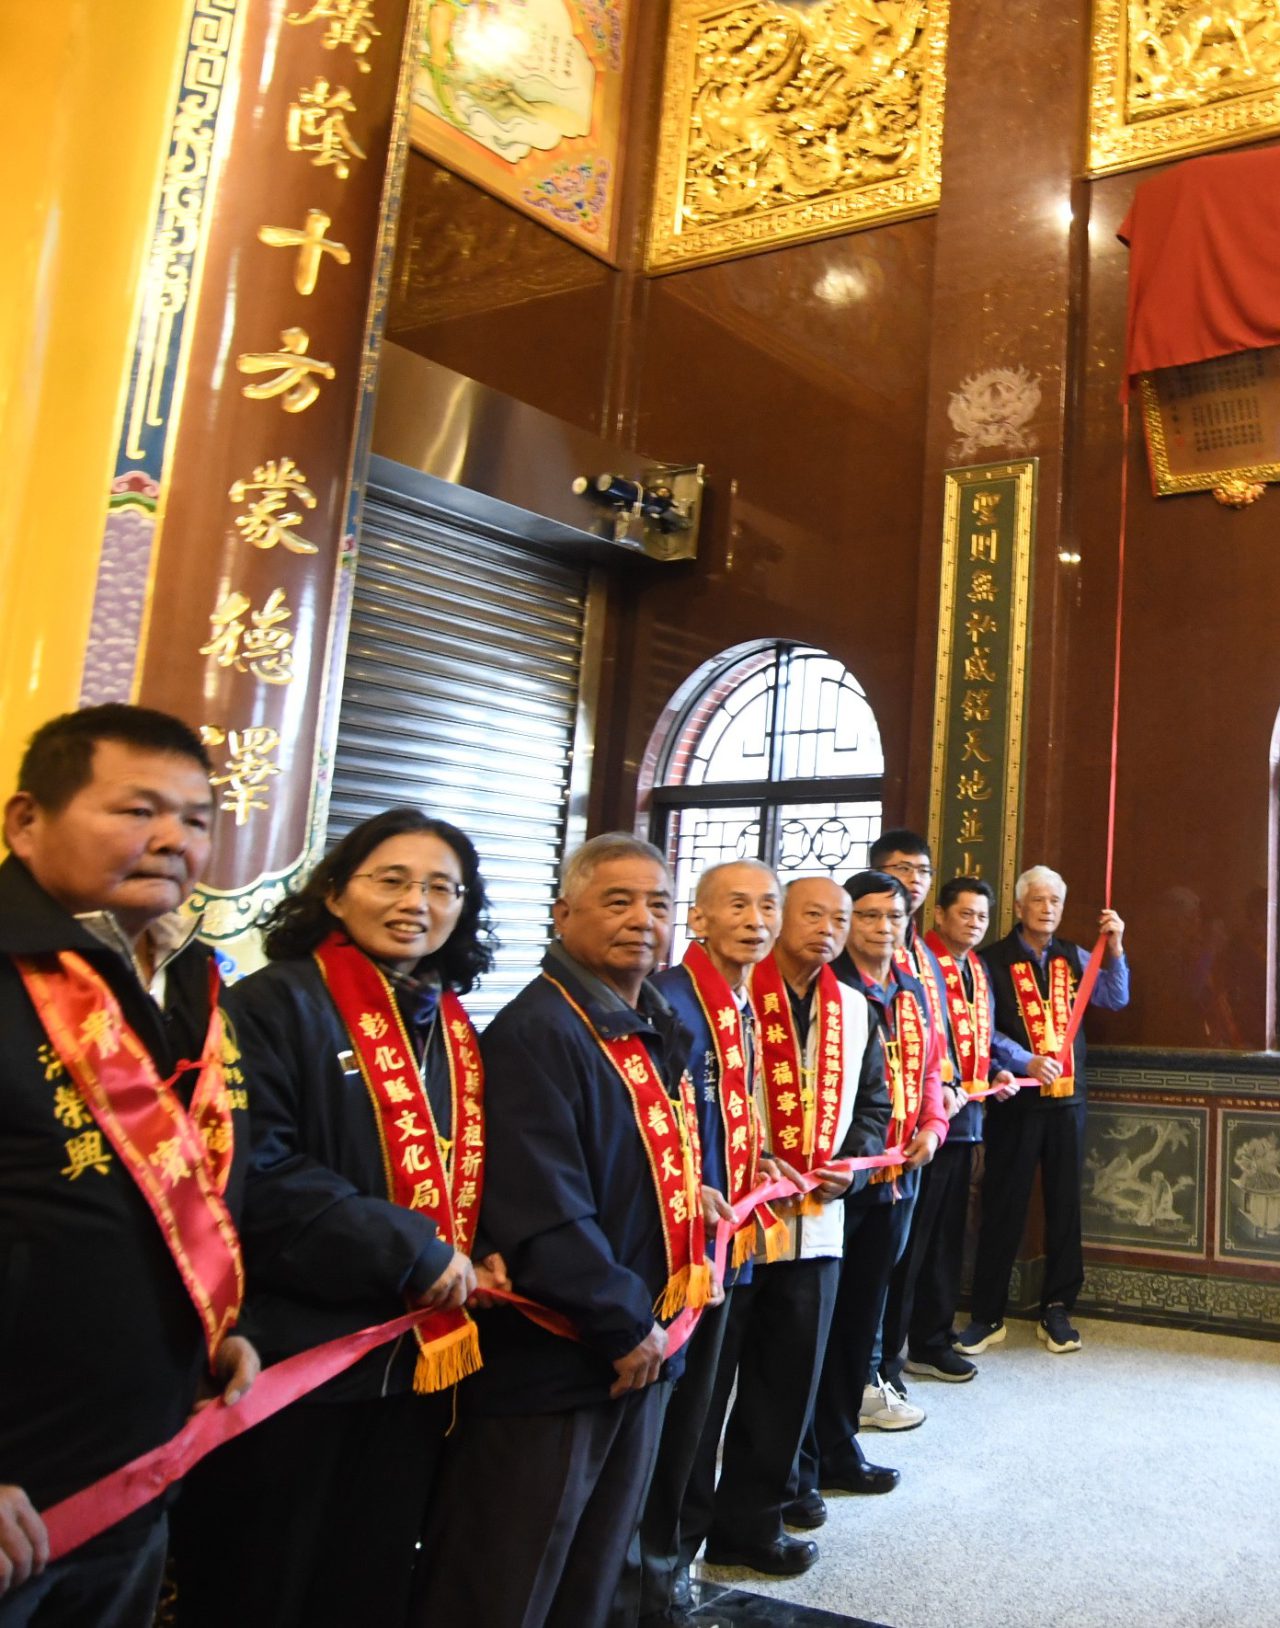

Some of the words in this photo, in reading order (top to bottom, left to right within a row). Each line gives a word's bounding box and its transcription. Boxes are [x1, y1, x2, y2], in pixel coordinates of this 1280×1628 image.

[358, 1011, 447, 1242] 彰化縣文化局
[450, 1018, 484, 1251] 彰化縣媽祖祈福文
[612, 1034, 688, 1224] 苑普天宮
[716, 1006, 749, 1192] 埤頭合興宮
[763, 992, 801, 1151] 員林福寧宮
[817, 1000, 842, 1152] 彰化縣媽祖祈福文化節
